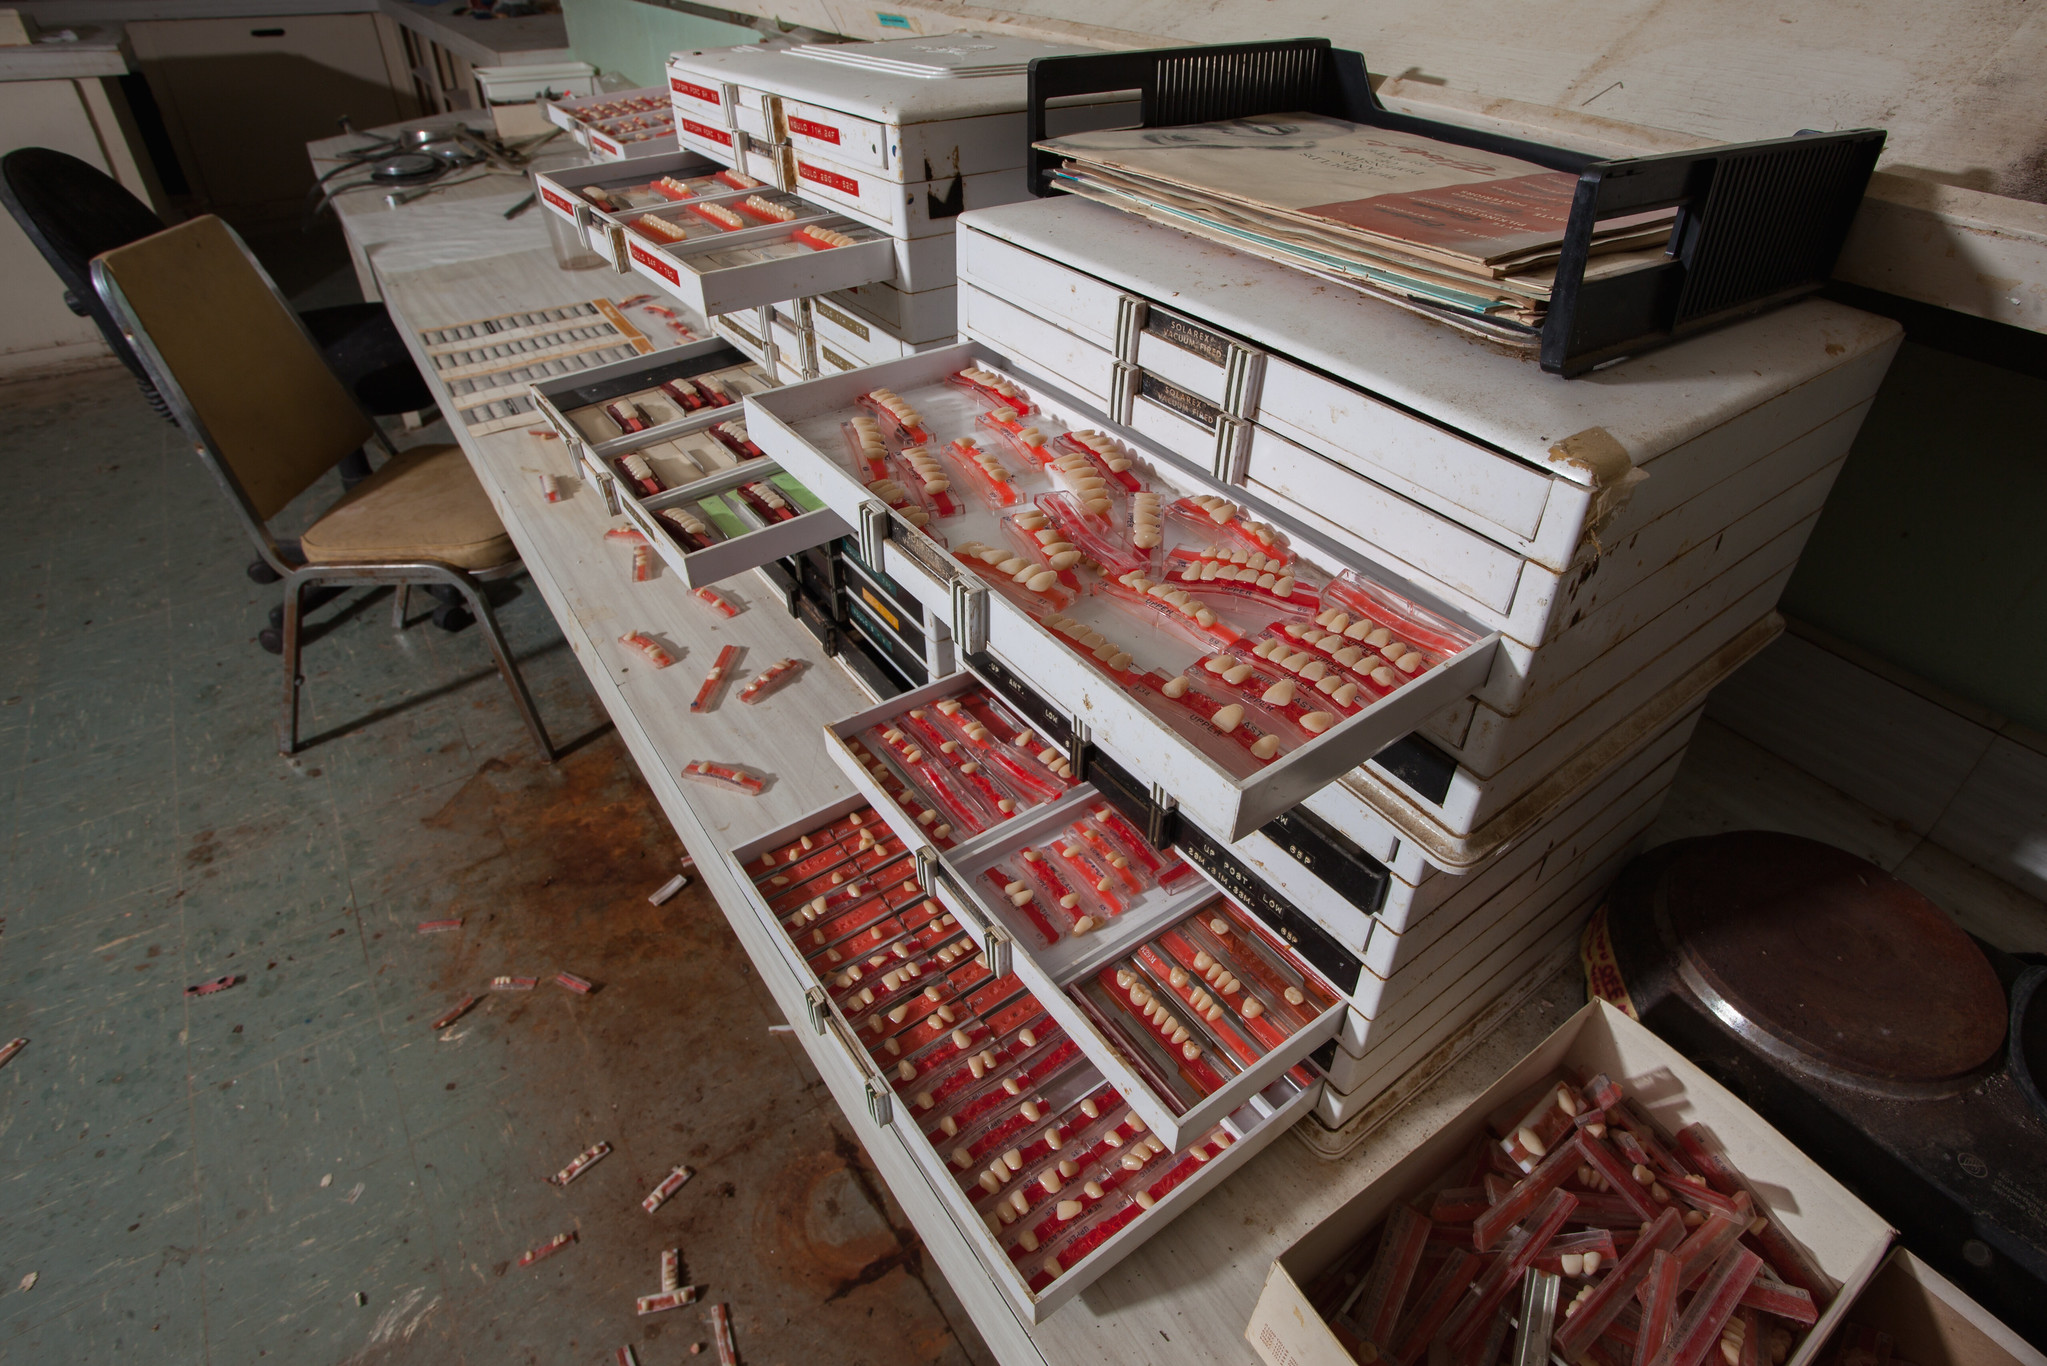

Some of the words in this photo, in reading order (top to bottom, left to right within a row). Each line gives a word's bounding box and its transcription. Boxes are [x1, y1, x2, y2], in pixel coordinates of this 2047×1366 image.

[1163, 328, 1195, 346] VACUUM
[1200, 343, 1222, 358] FIRED
[1157, 391, 1189, 412] VACUUM
[1192, 408, 1214, 424] FIRED
[1221, 586, 1253, 597] UPPER
[1146, 599, 1173, 616] UPPER
[1347, 640, 1378, 659] UPPER
[1315, 655, 1346, 675] UPPER
[1283, 672, 1314, 693] UPPER
[1242, 692, 1274, 712] UPPER
[1045, 709, 1058, 723] LOW
[1190, 714, 1222, 737] UPPER
[1203, 844, 1216, 857] UP
[1262, 893, 1283, 915] LOW
[1088, 1203, 1102, 1215] NEW
[1066, 1226, 1089, 1245] UPPER
